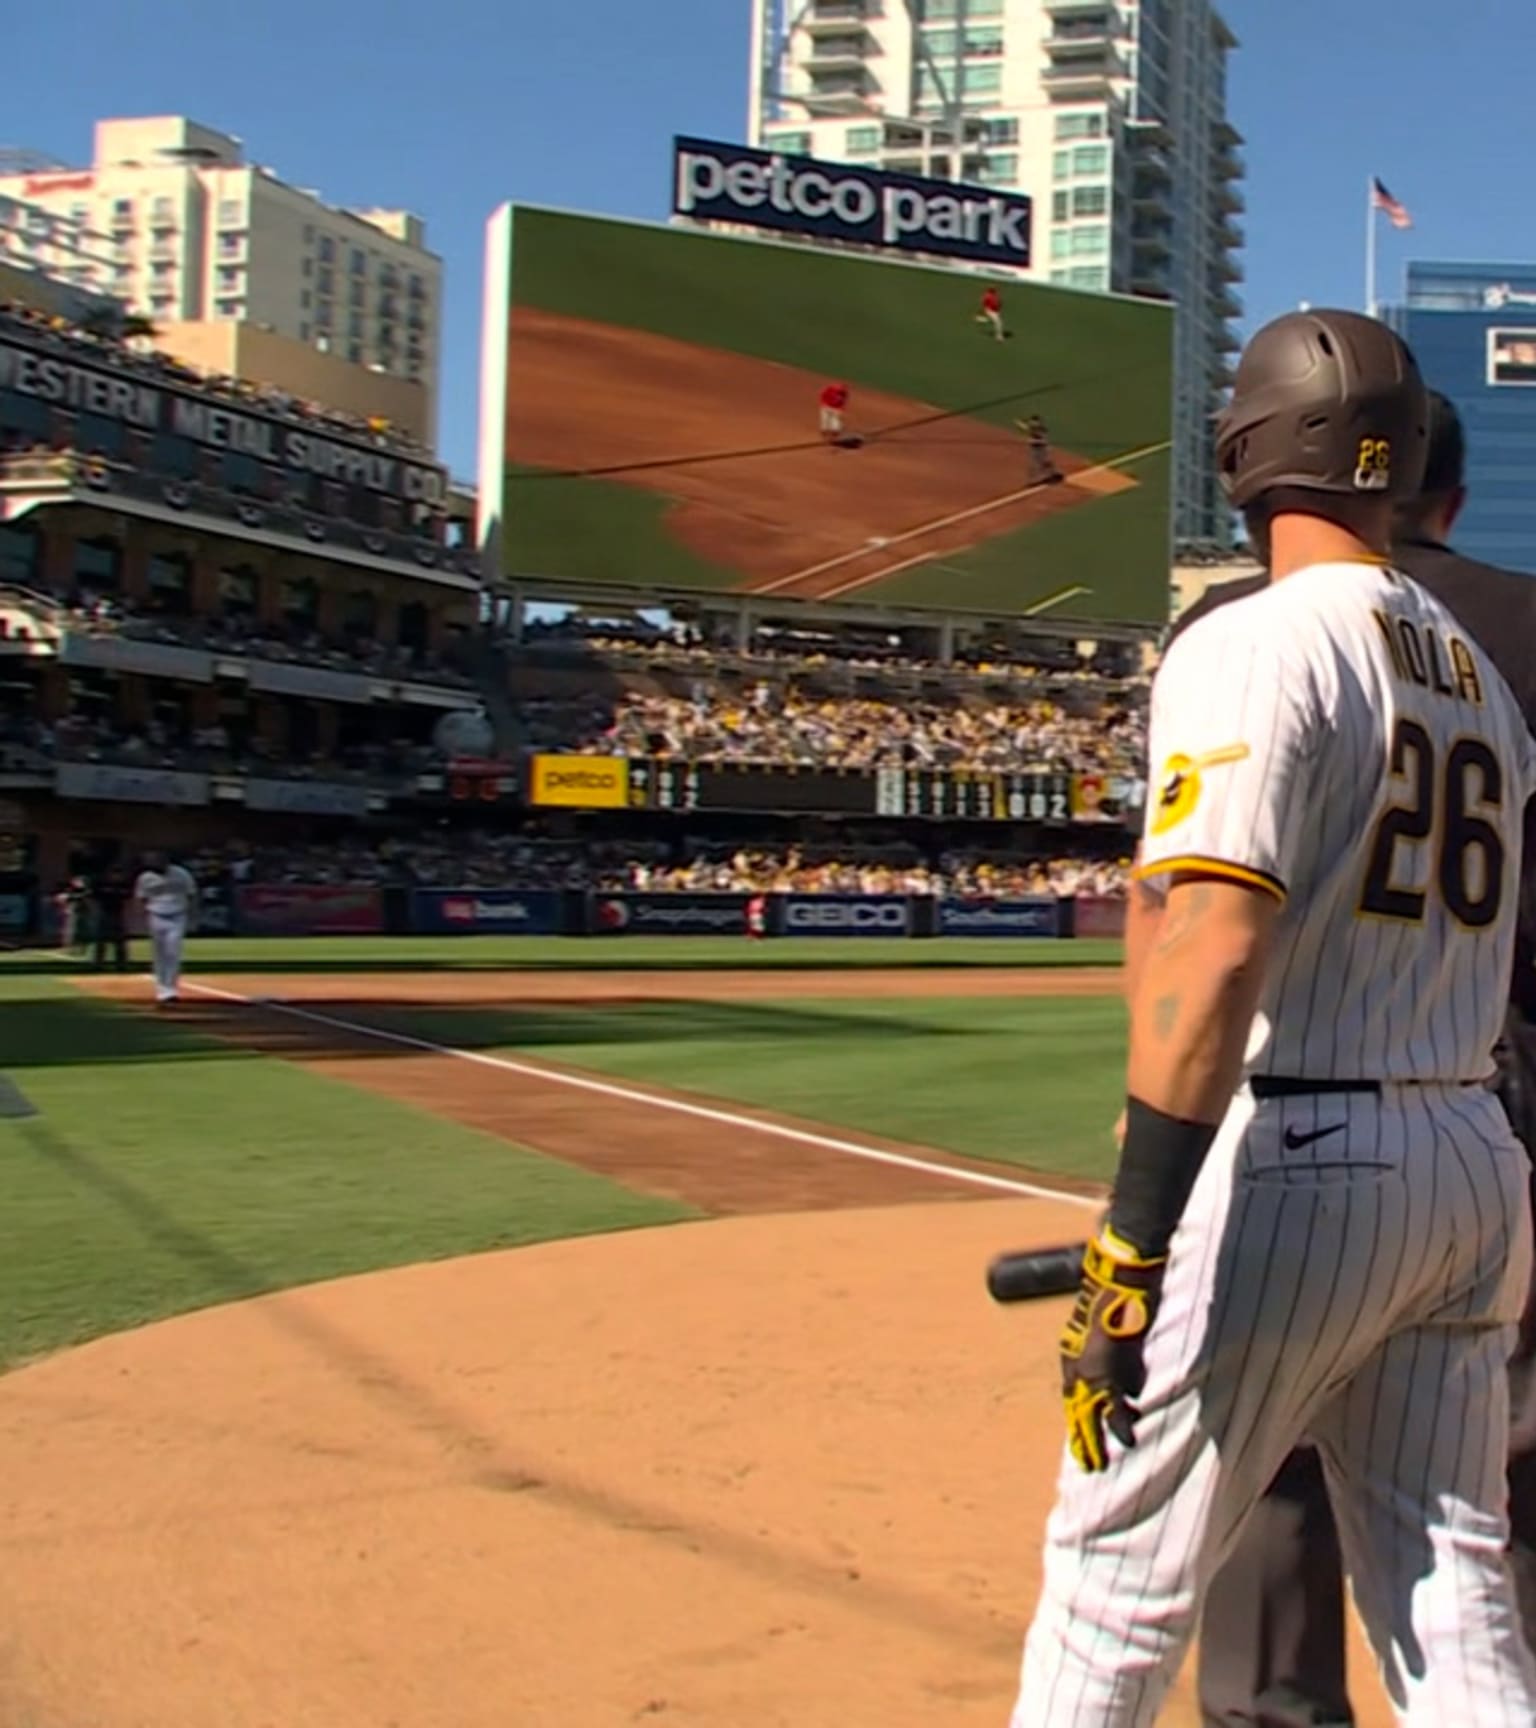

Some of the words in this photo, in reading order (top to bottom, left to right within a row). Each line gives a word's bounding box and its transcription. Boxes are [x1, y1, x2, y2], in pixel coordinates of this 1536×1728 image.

[678, 152, 876, 223] petco
[882, 186, 1027, 249] park
[174, 395, 279, 461] METAL
[285, 431, 397, 491] SUPPLY
[1373, 608, 1484, 703] NOLA
[1355, 715, 1504, 932] 26
[786, 902, 906, 927] GEICO
